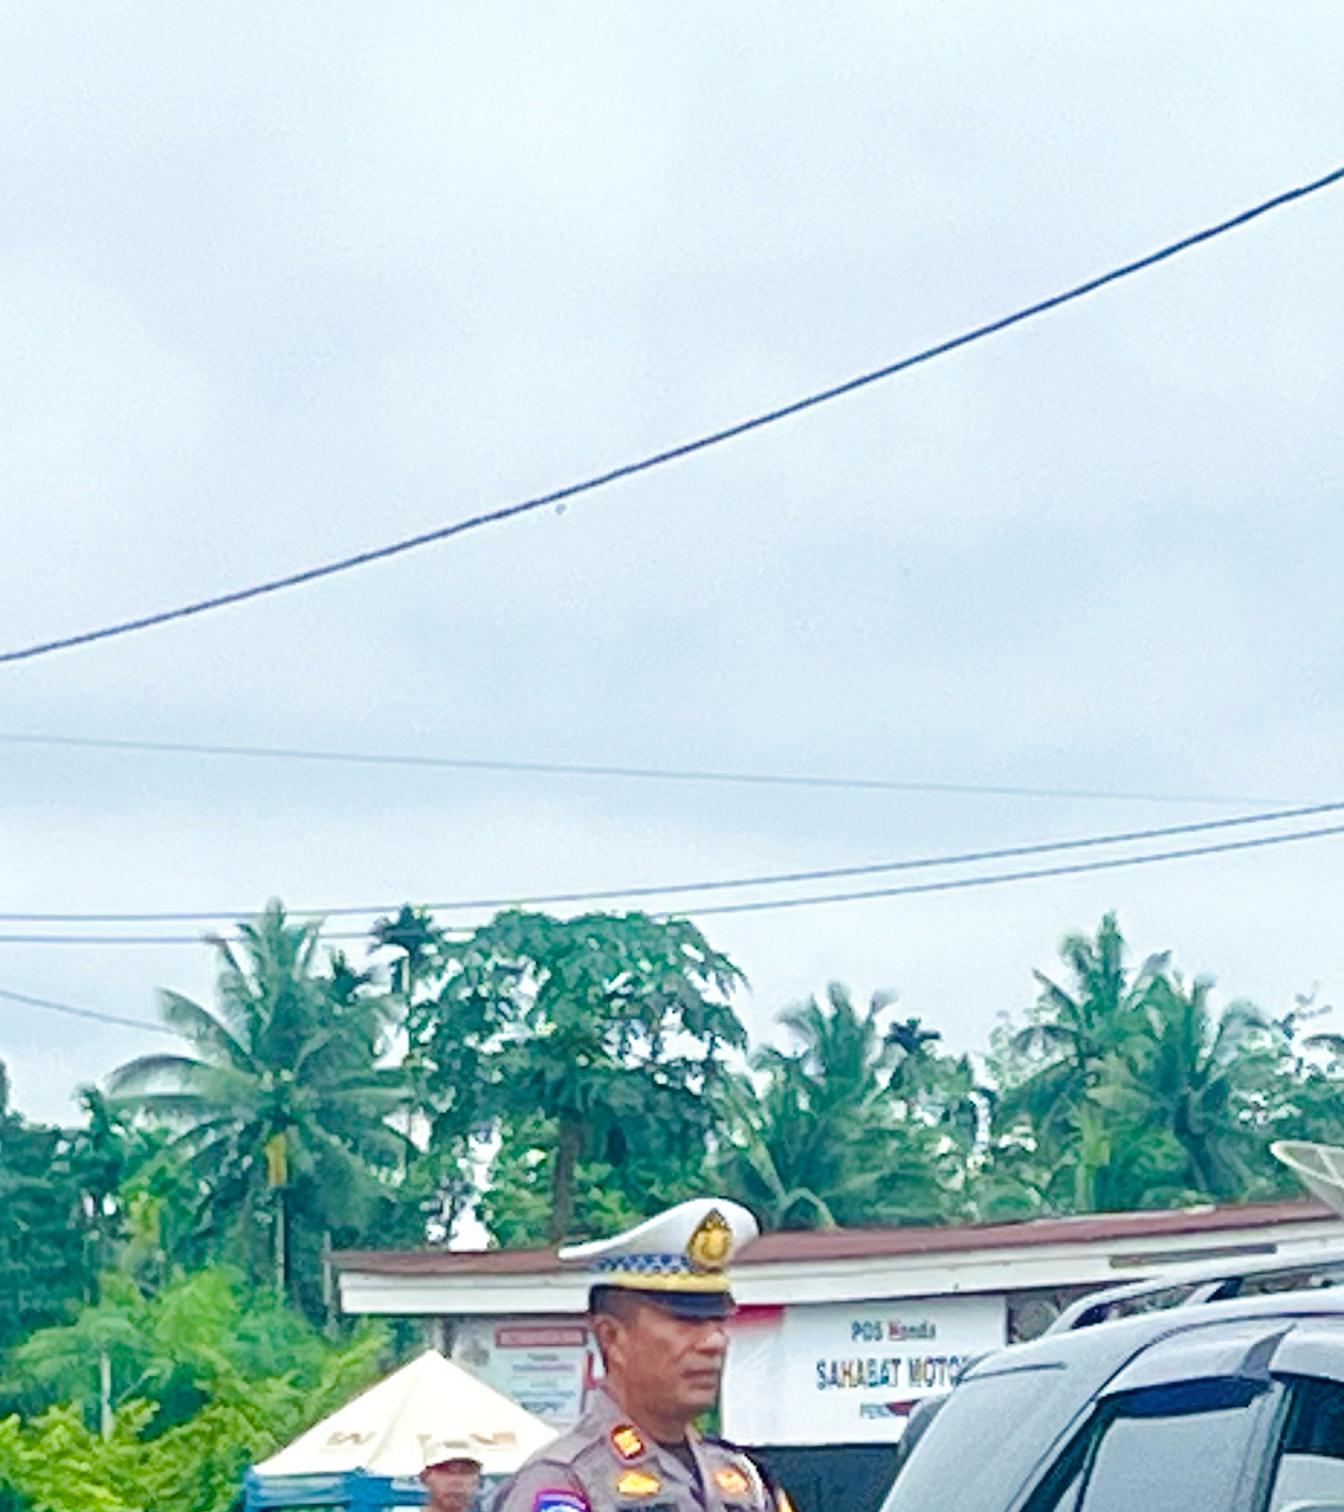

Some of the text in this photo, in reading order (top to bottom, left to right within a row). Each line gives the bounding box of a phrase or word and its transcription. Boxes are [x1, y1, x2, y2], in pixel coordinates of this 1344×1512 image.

[851, 1319, 936, 1342] POS Honda
[816, 1356, 902, 1391] SAHABAT
